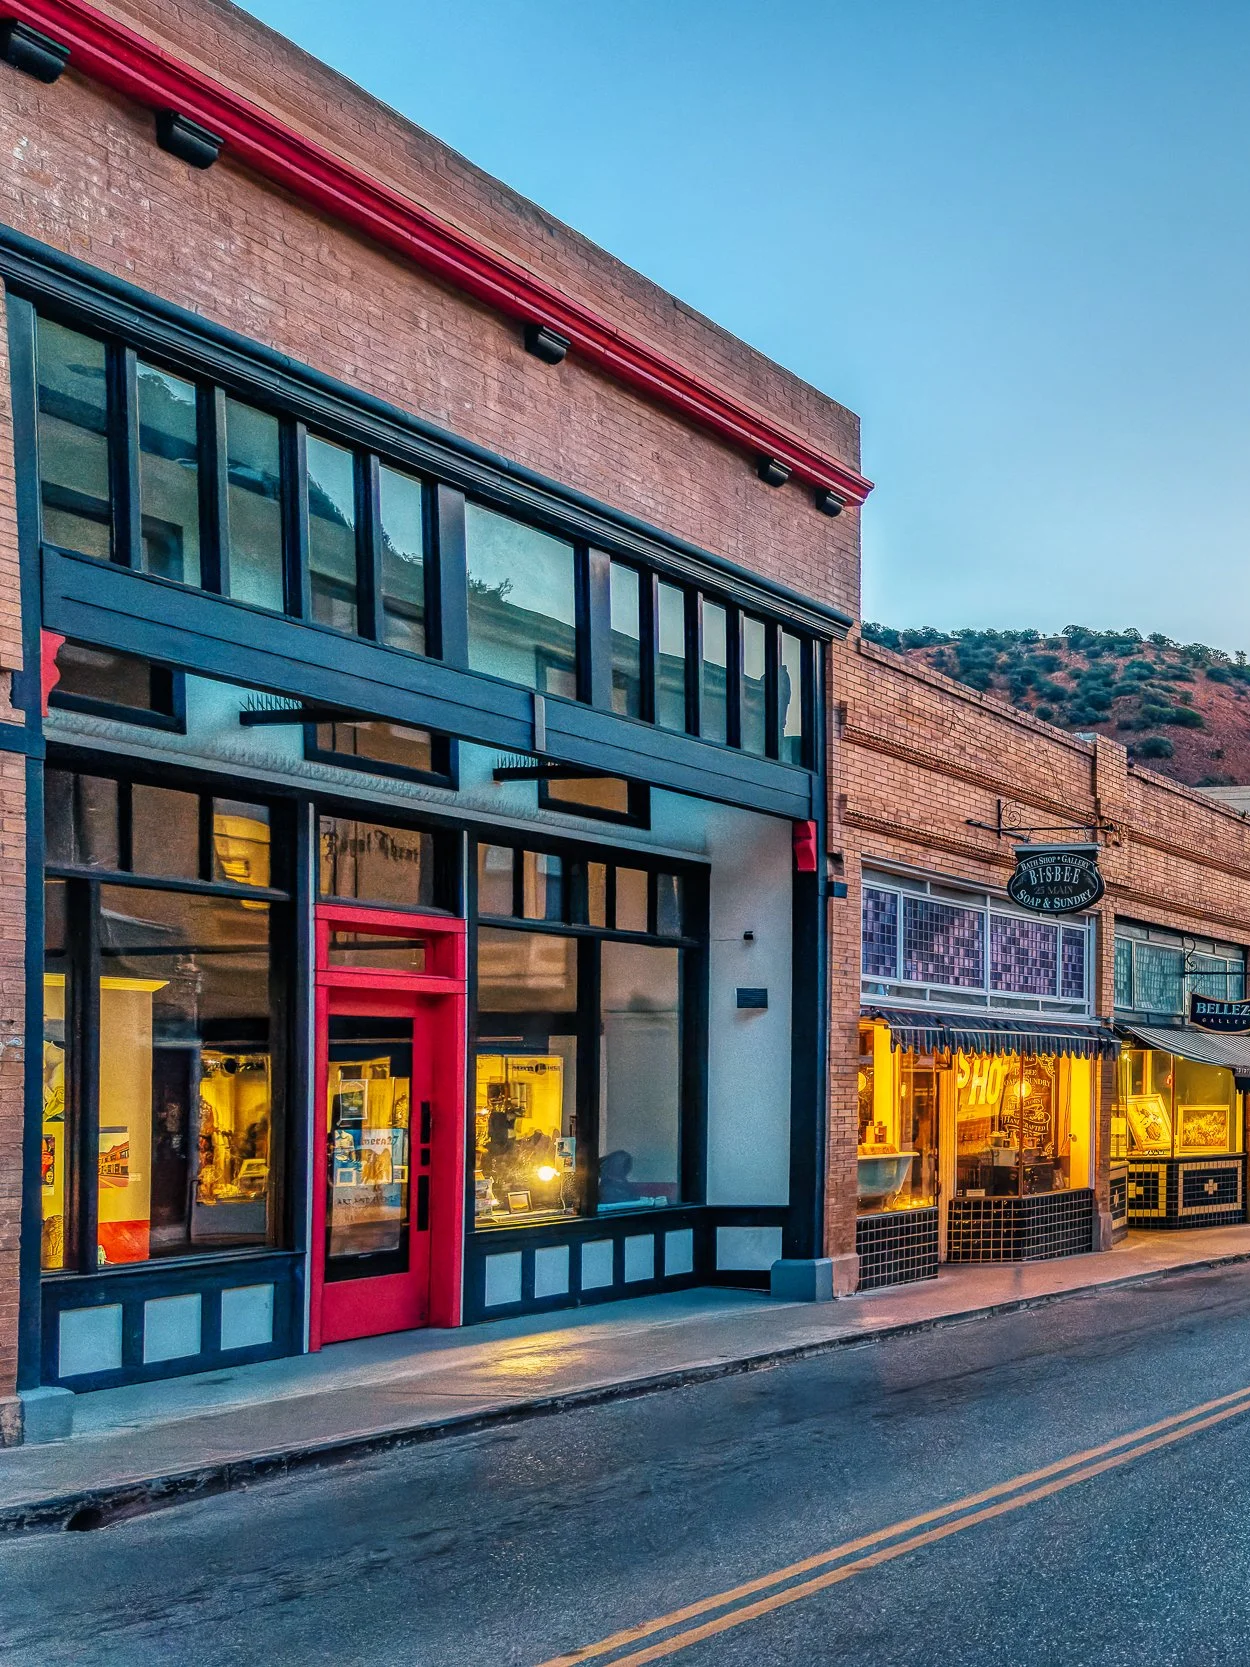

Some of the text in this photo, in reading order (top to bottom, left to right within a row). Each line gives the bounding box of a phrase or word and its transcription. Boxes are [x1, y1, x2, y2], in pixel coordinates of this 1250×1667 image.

[1020, 854, 1091, 871] BATH SHOP GALLERY
[1017, 888, 1092, 909] SOAP & SUNDRY
[1047, 885, 1074, 895] MAIN
[957, 1050, 1005, 1105] SHO
